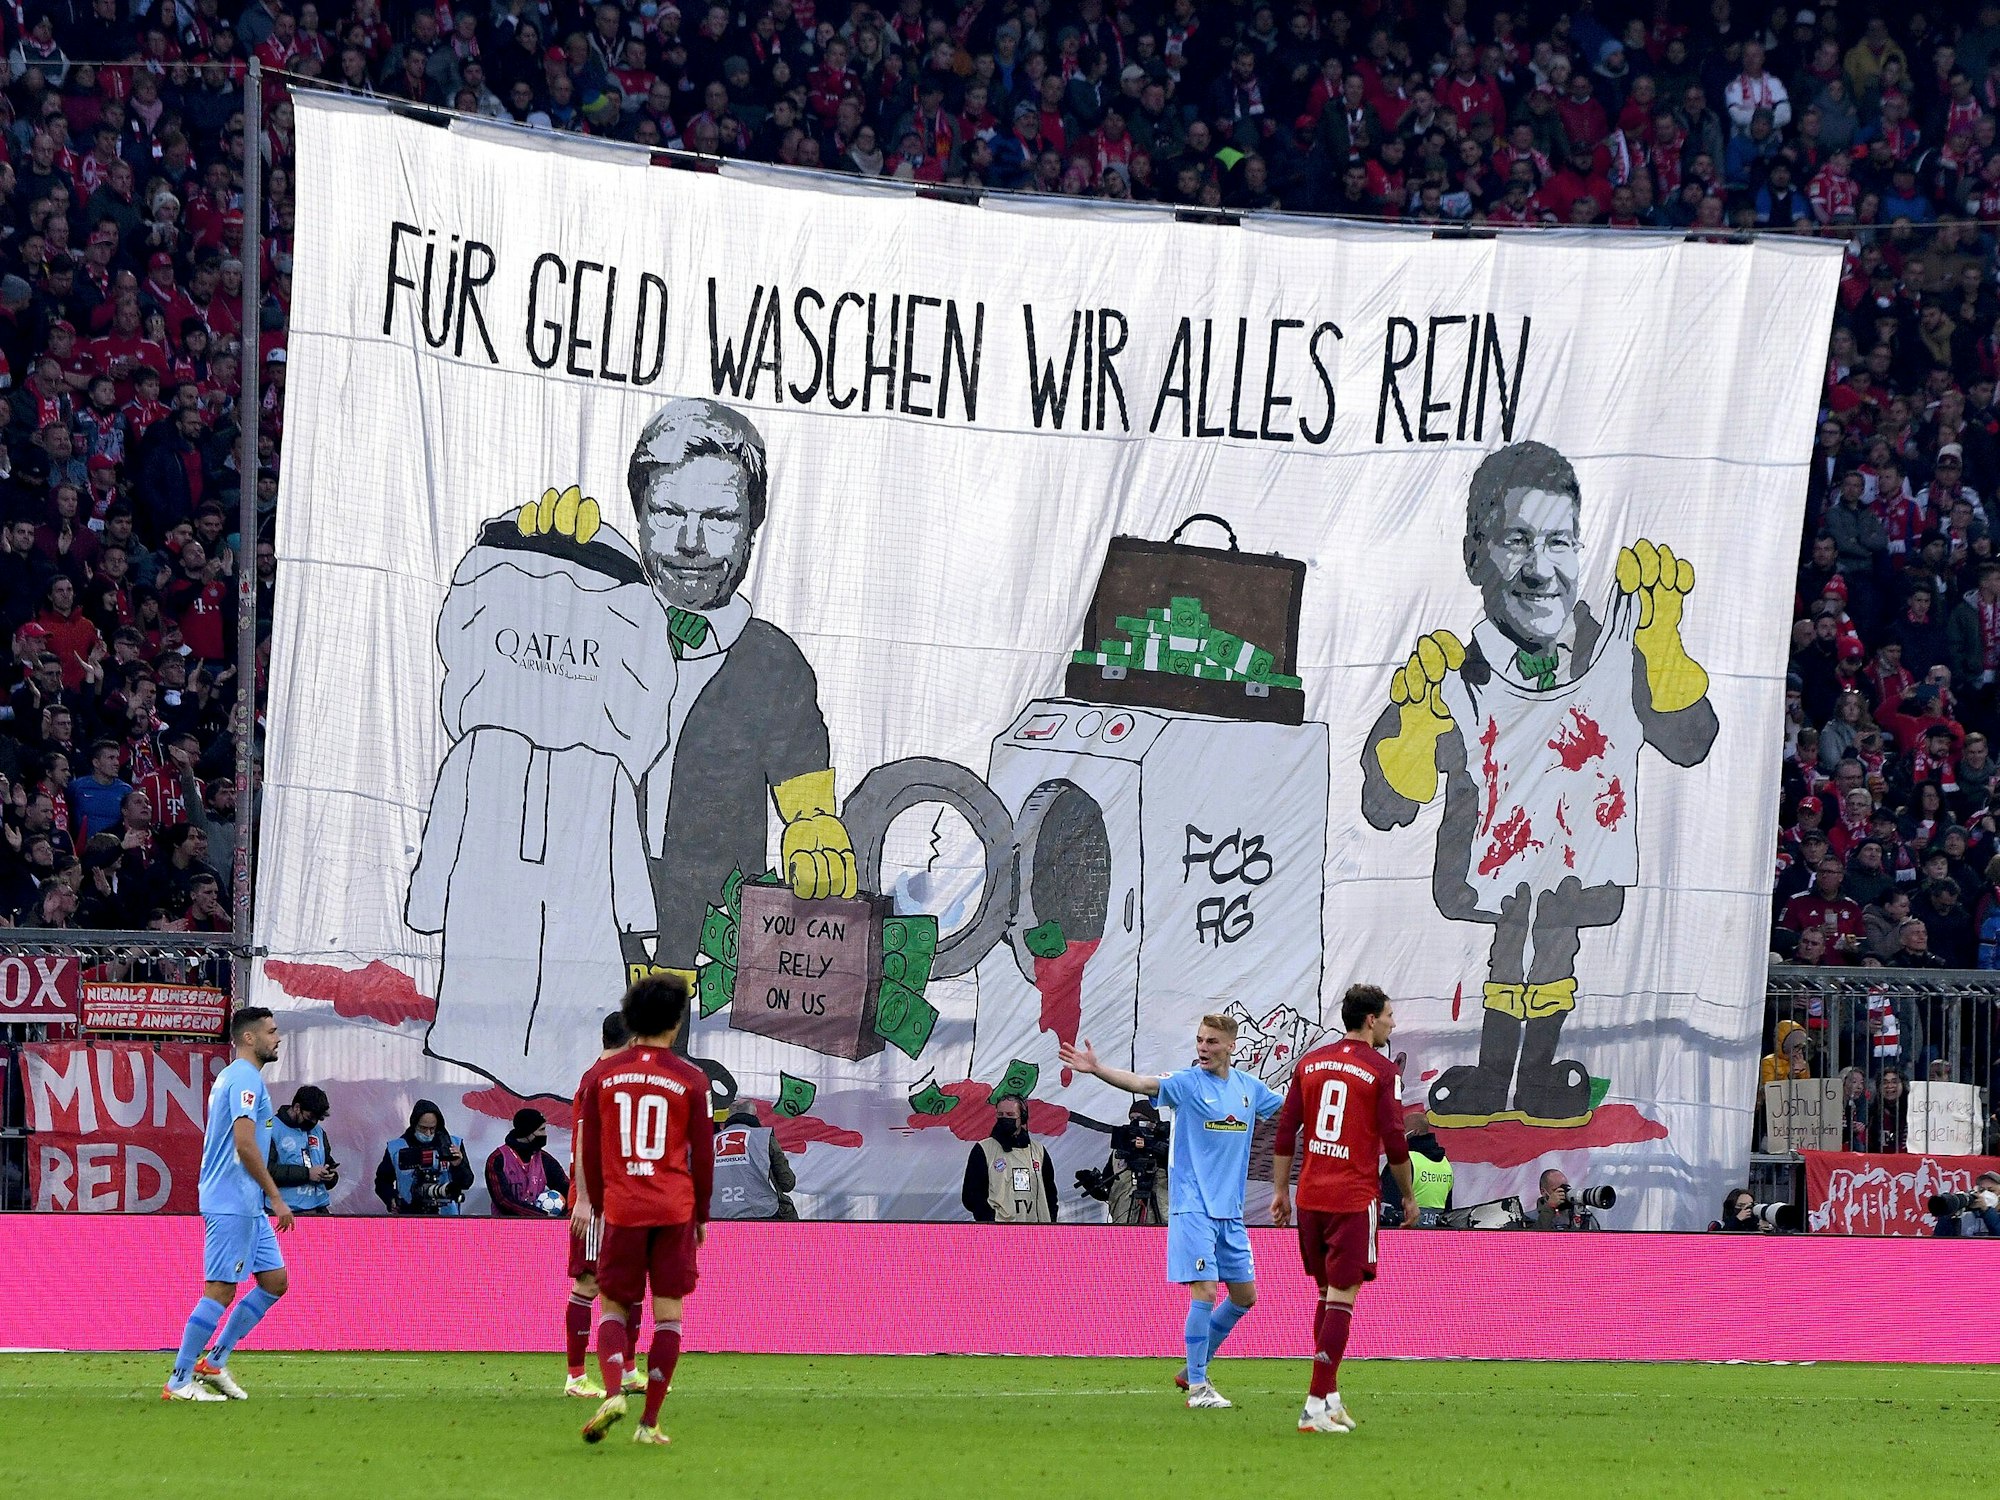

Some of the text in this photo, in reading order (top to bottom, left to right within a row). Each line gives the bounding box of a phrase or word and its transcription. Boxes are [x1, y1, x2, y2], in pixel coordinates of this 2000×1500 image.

[384, 221, 1531, 444] FÜR GELD WASCHEN WIR ALLES REIN
[495, 628, 600, 667] QATAR
[519, 659, 565, 676] AIRWAYS
[1183, 823, 1273, 886] FCB
[763, 916, 846, 942] YOU CAN
[1196, 890, 1254, 948] AG
[779, 951, 833, 979] RELY
[87, 987, 224, 1005] NIEMALS ABWESEND
[766, 988, 827, 1016] ON US
[86, 1012, 221, 1031] IMMER ANWESEND
[602, 1077, 613, 1089] FC
[613, 1073, 646, 1085] BAYERN
[1305, 1064, 1314, 1075] FC
[1315, 1061, 1343, 1072] BAYERN
[1826, 1080, 1836, 1100] 6
[1315, 1079, 1348, 1142] 8
[614, 1091, 668, 1160] 10
[36, 1143, 173, 1213] RED
[721, 1186, 745, 1203] 22
[1014, 1199, 1033, 1214] TV
